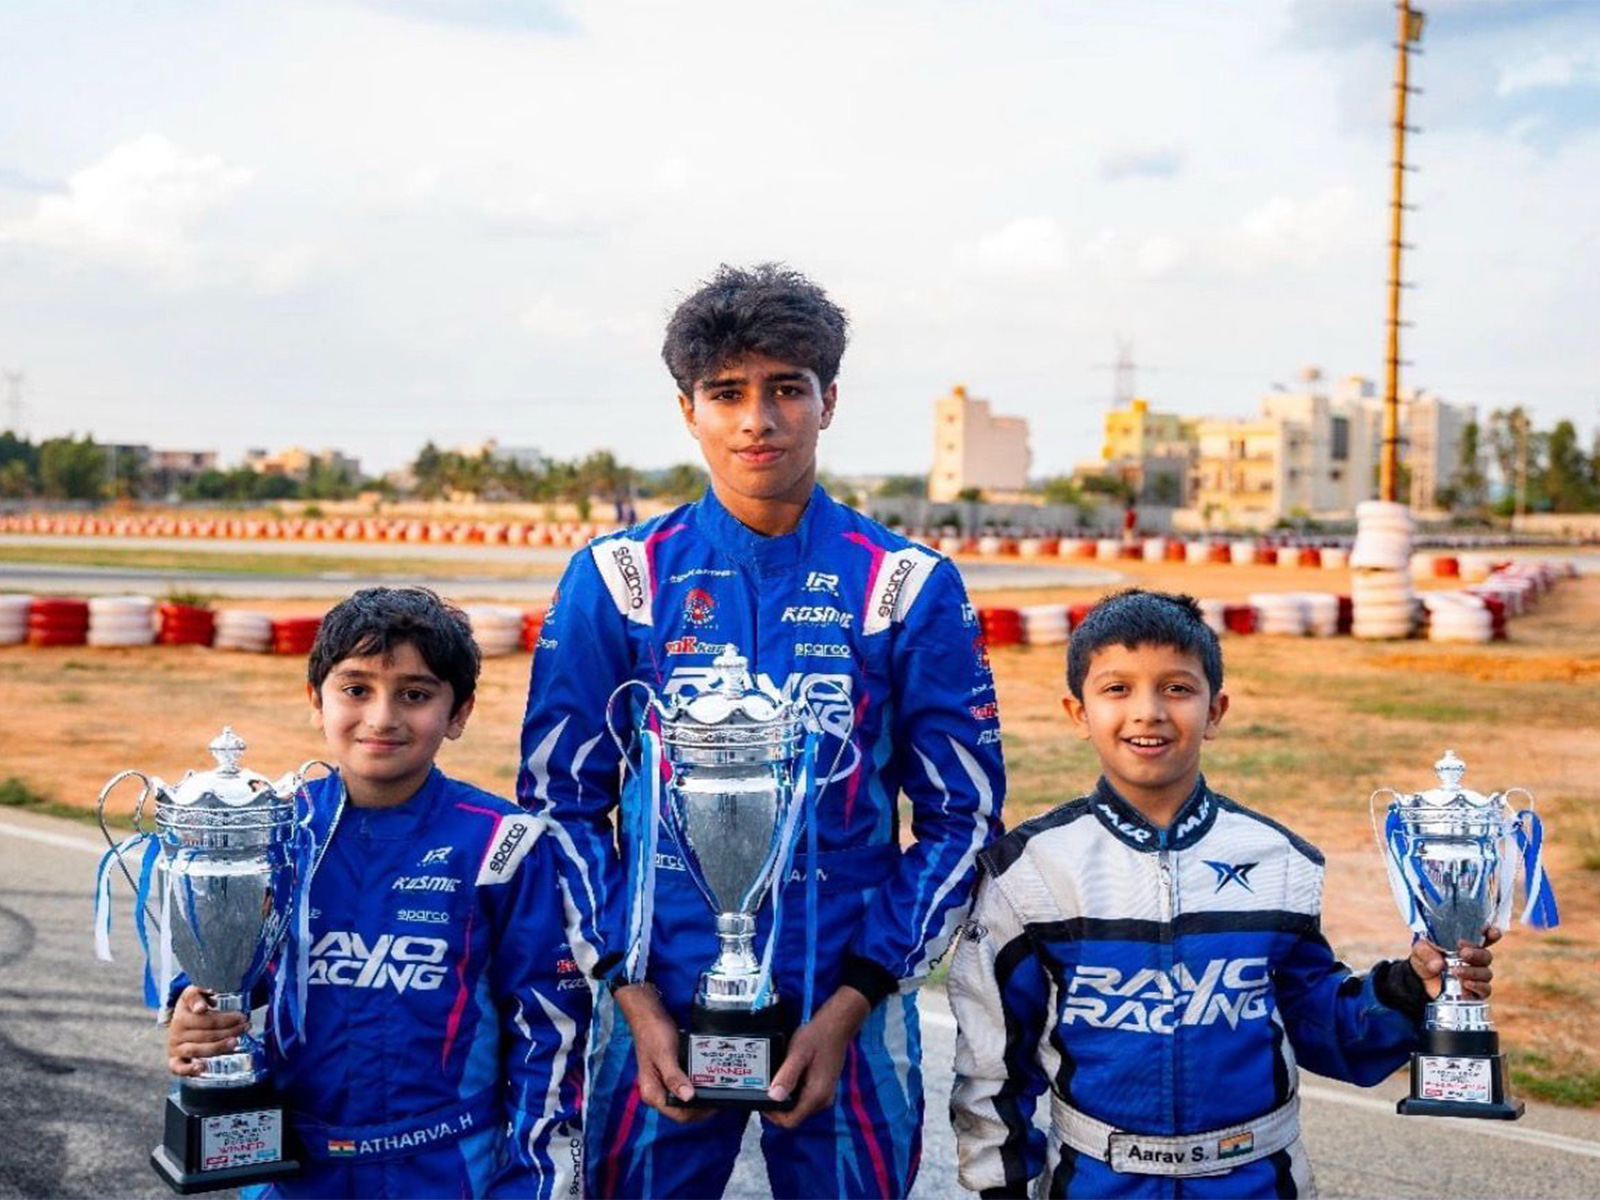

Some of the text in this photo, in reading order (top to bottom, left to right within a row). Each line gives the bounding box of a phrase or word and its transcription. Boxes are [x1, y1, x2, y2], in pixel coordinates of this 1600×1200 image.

[612, 546, 644, 609] sparco
[878, 559, 918, 618] sparco
[794, 643, 851, 658] sparco
[490, 823, 528, 875] sparco
[397, 909, 450, 924] sparco
[309, 931, 449, 974] AYO
[307, 959, 449, 995] ACING
[360, 1112, 474, 1154] ATHARVA. H
[1128, 1144, 1210, 1164] Aarav S.
